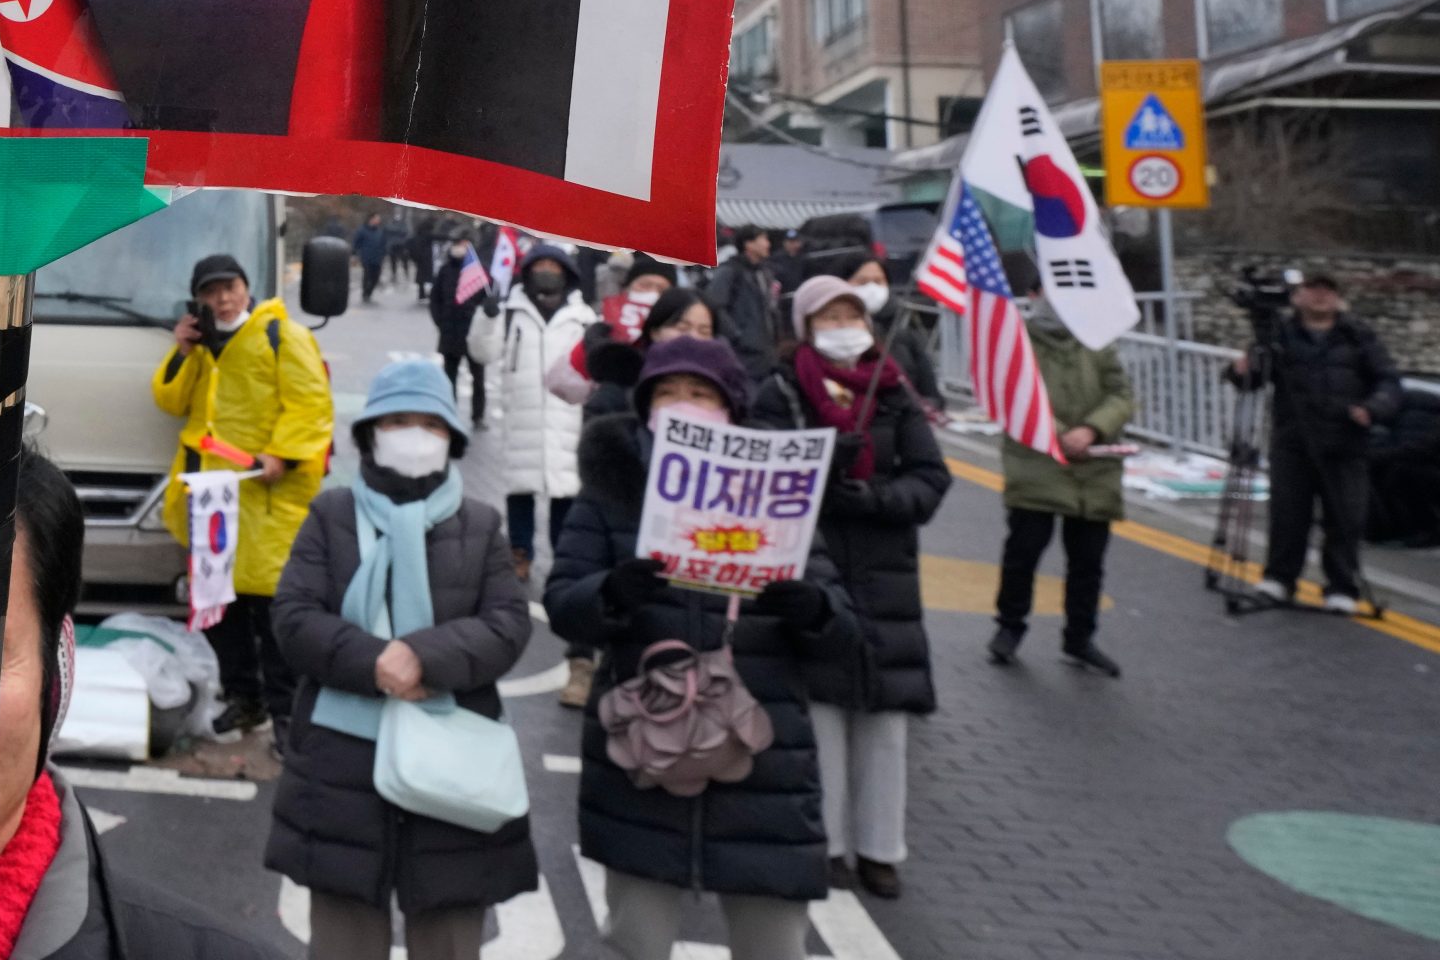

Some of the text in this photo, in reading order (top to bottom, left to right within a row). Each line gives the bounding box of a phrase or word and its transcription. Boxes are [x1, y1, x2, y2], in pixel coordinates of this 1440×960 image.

[1139, 165, 1174, 188] 20
[667, 417, 713, 452] 전과
[722, 433, 771, 463] 12범
[656, 452, 819, 519] 이재명
